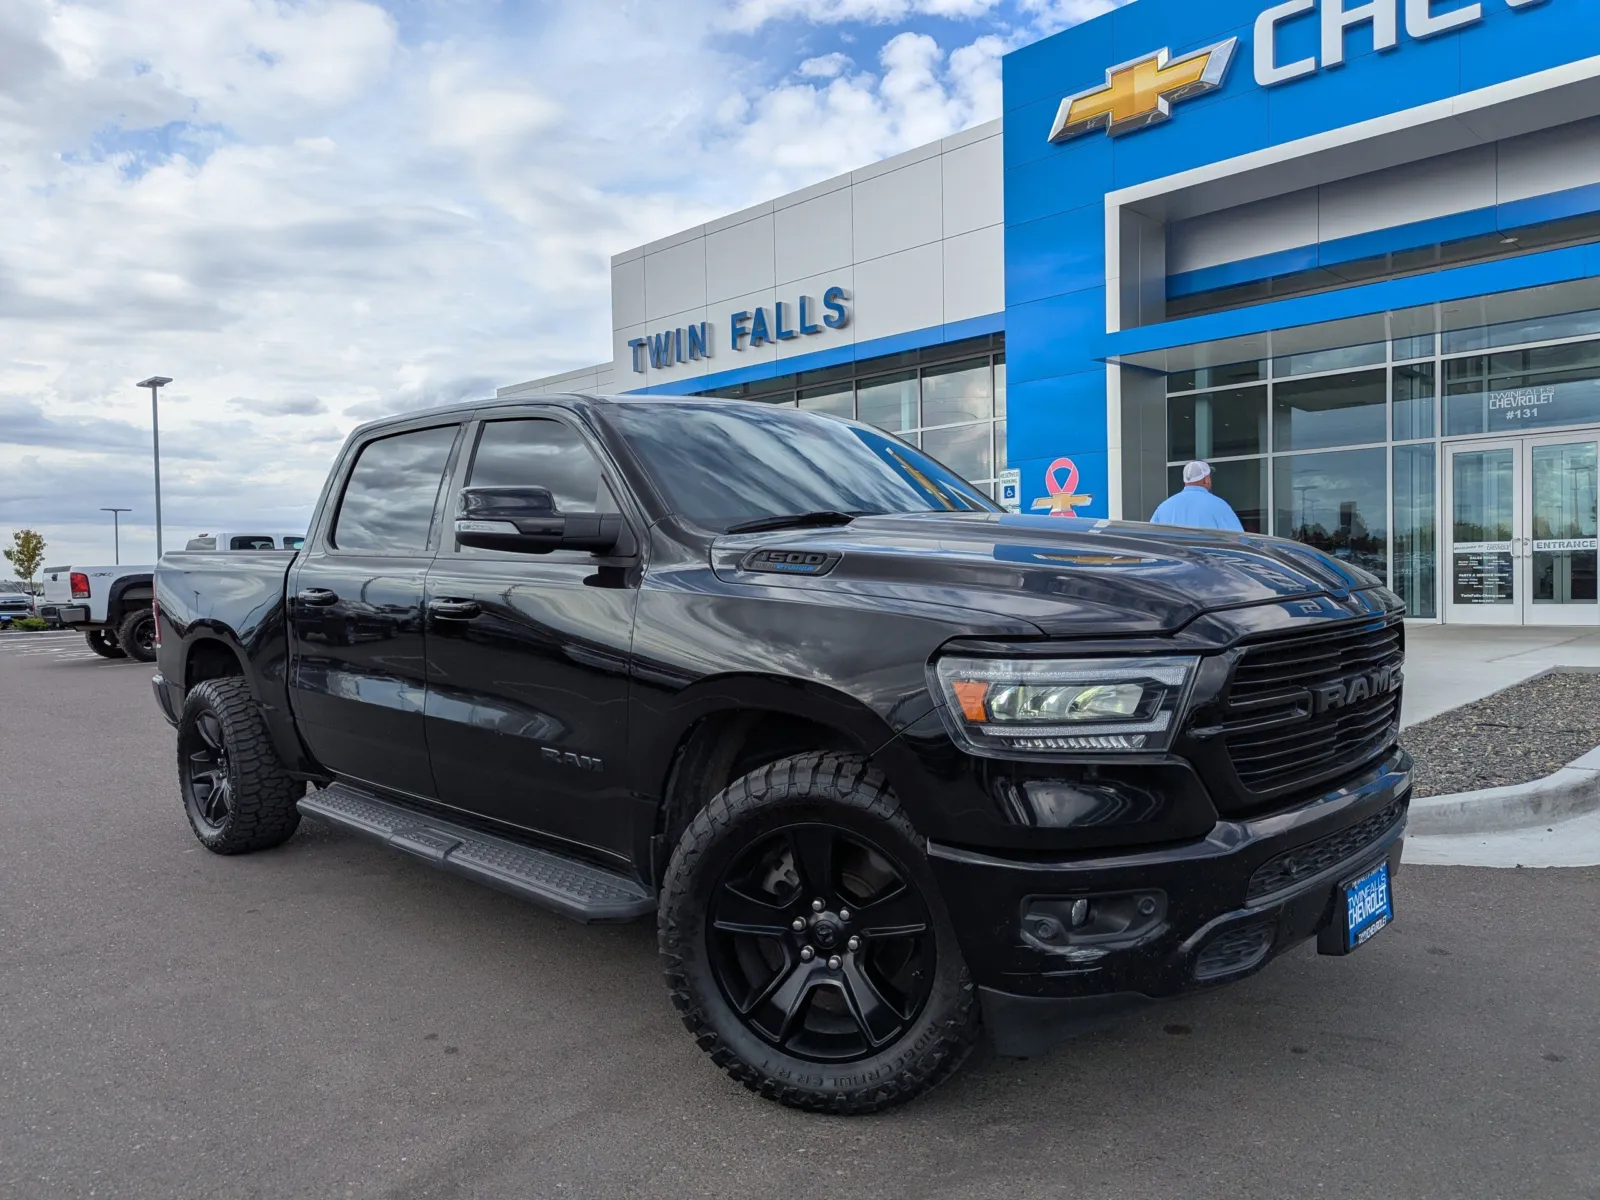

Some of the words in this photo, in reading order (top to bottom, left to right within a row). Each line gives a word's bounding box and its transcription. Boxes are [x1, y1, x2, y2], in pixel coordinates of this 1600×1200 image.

[1253, 0, 1546, 86] CH
[628, 322, 711, 373] TWIN
[731, 286, 850, 351] FALLS
[1490, 394, 1555, 409] CHEVROLET
[1506, 408, 1538, 419] #131
[1536, 540, 1596, 550] ENTRANCE
[1316, 666, 1390, 713] RAM
[541, 747, 603, 772] RAM
[1348, 885, 1387, 929] CHEVROLET
